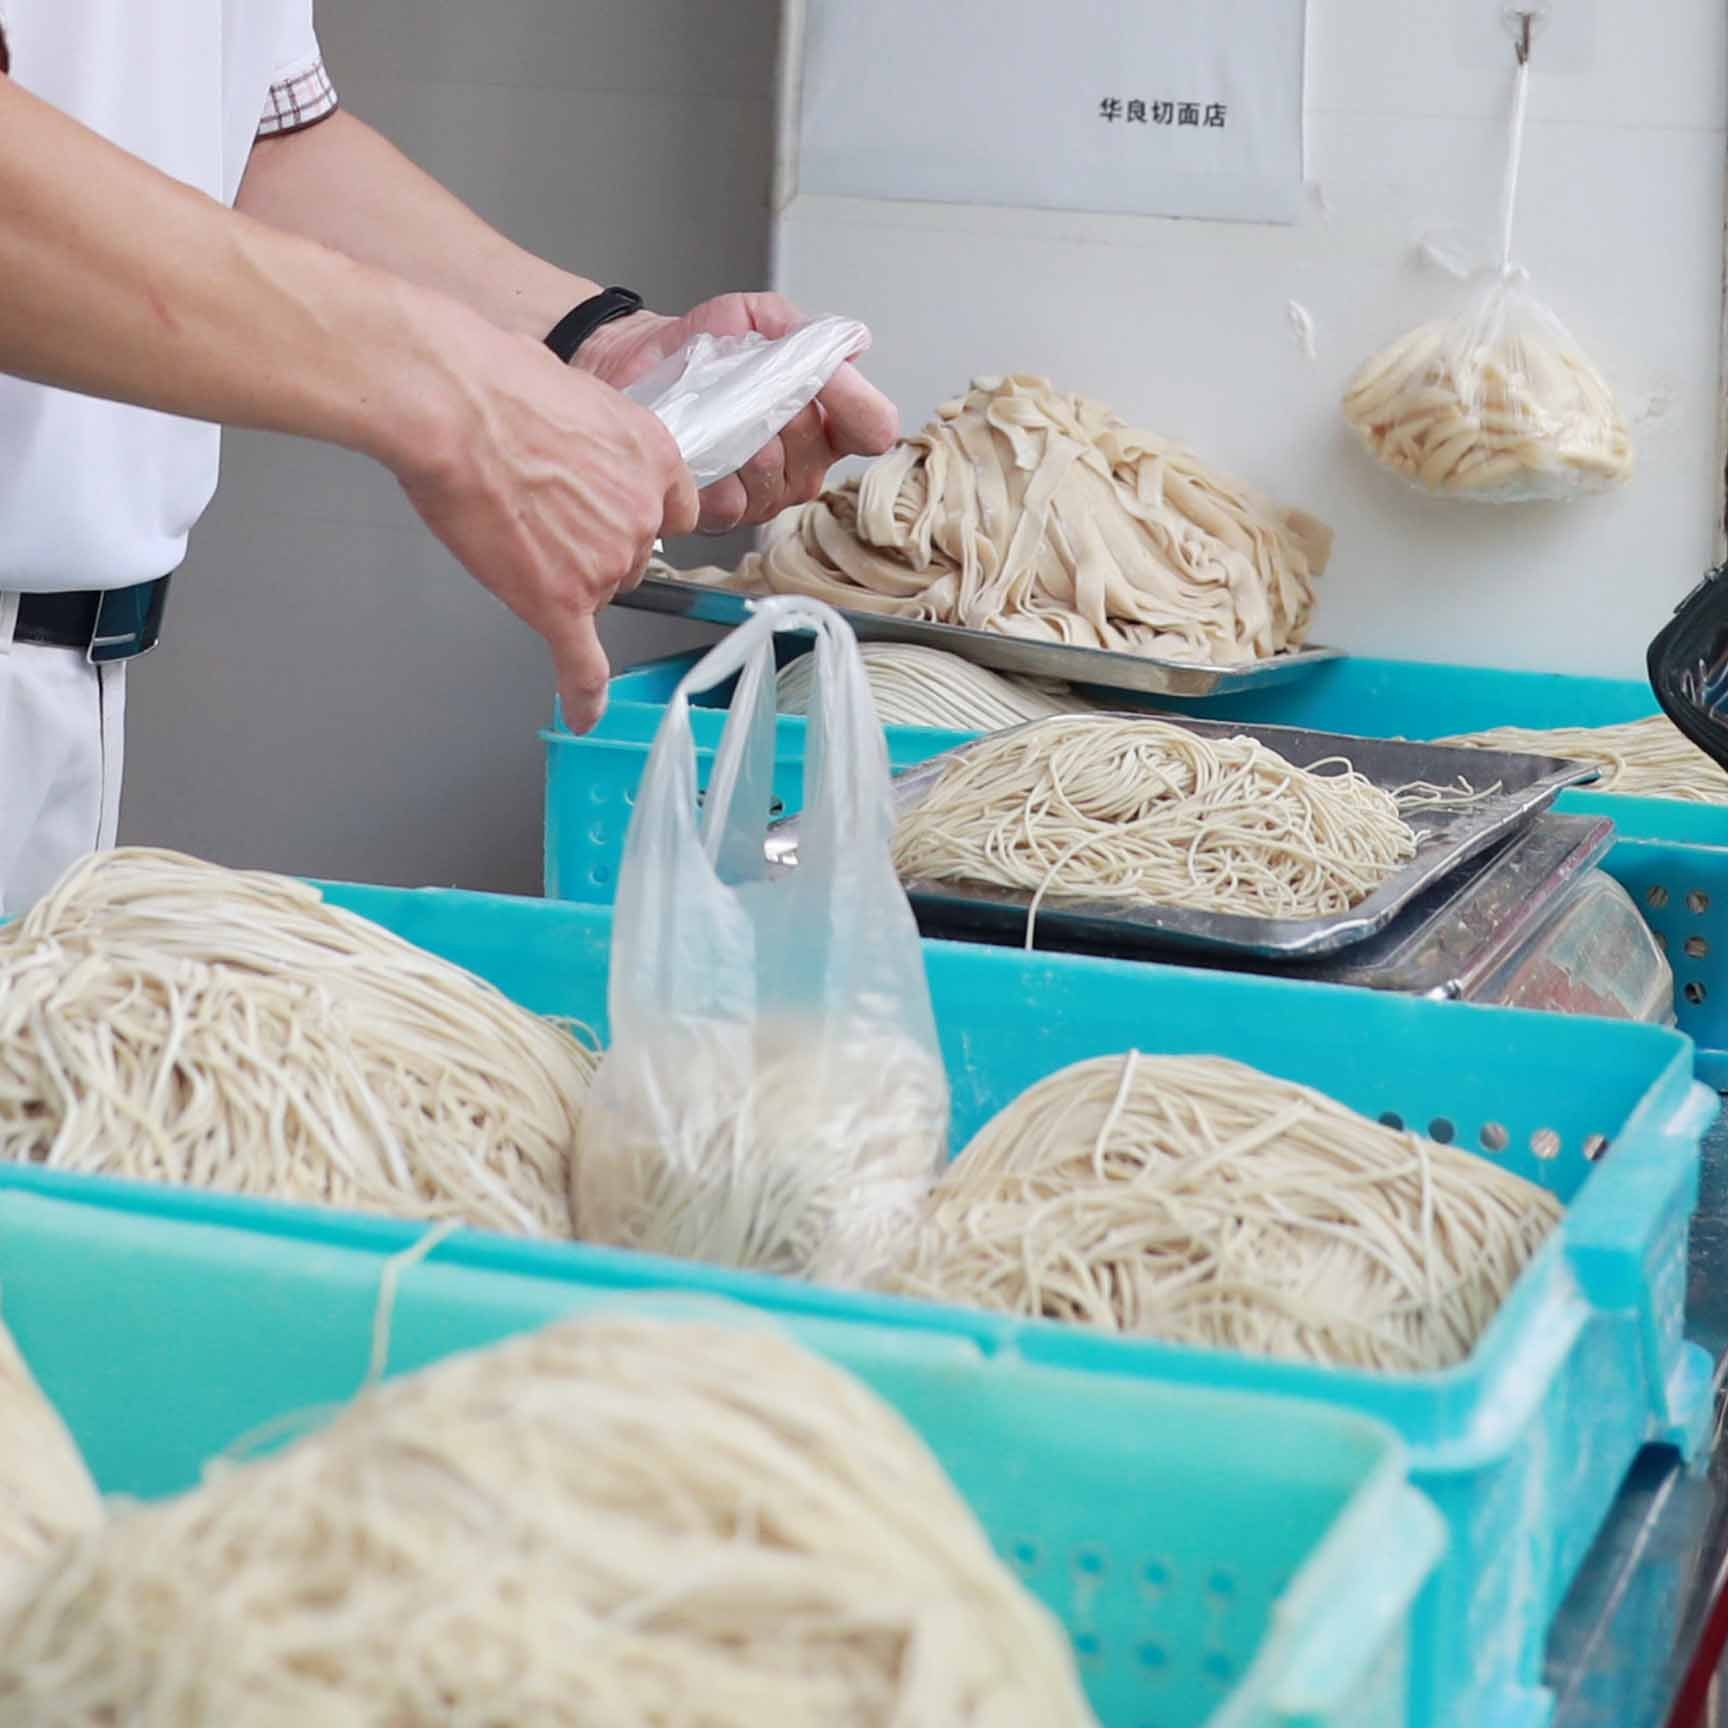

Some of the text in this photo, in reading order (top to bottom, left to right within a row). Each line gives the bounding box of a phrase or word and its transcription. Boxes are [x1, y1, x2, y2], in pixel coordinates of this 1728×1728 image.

[1100, 98, 1226, 127] 华良切面店
